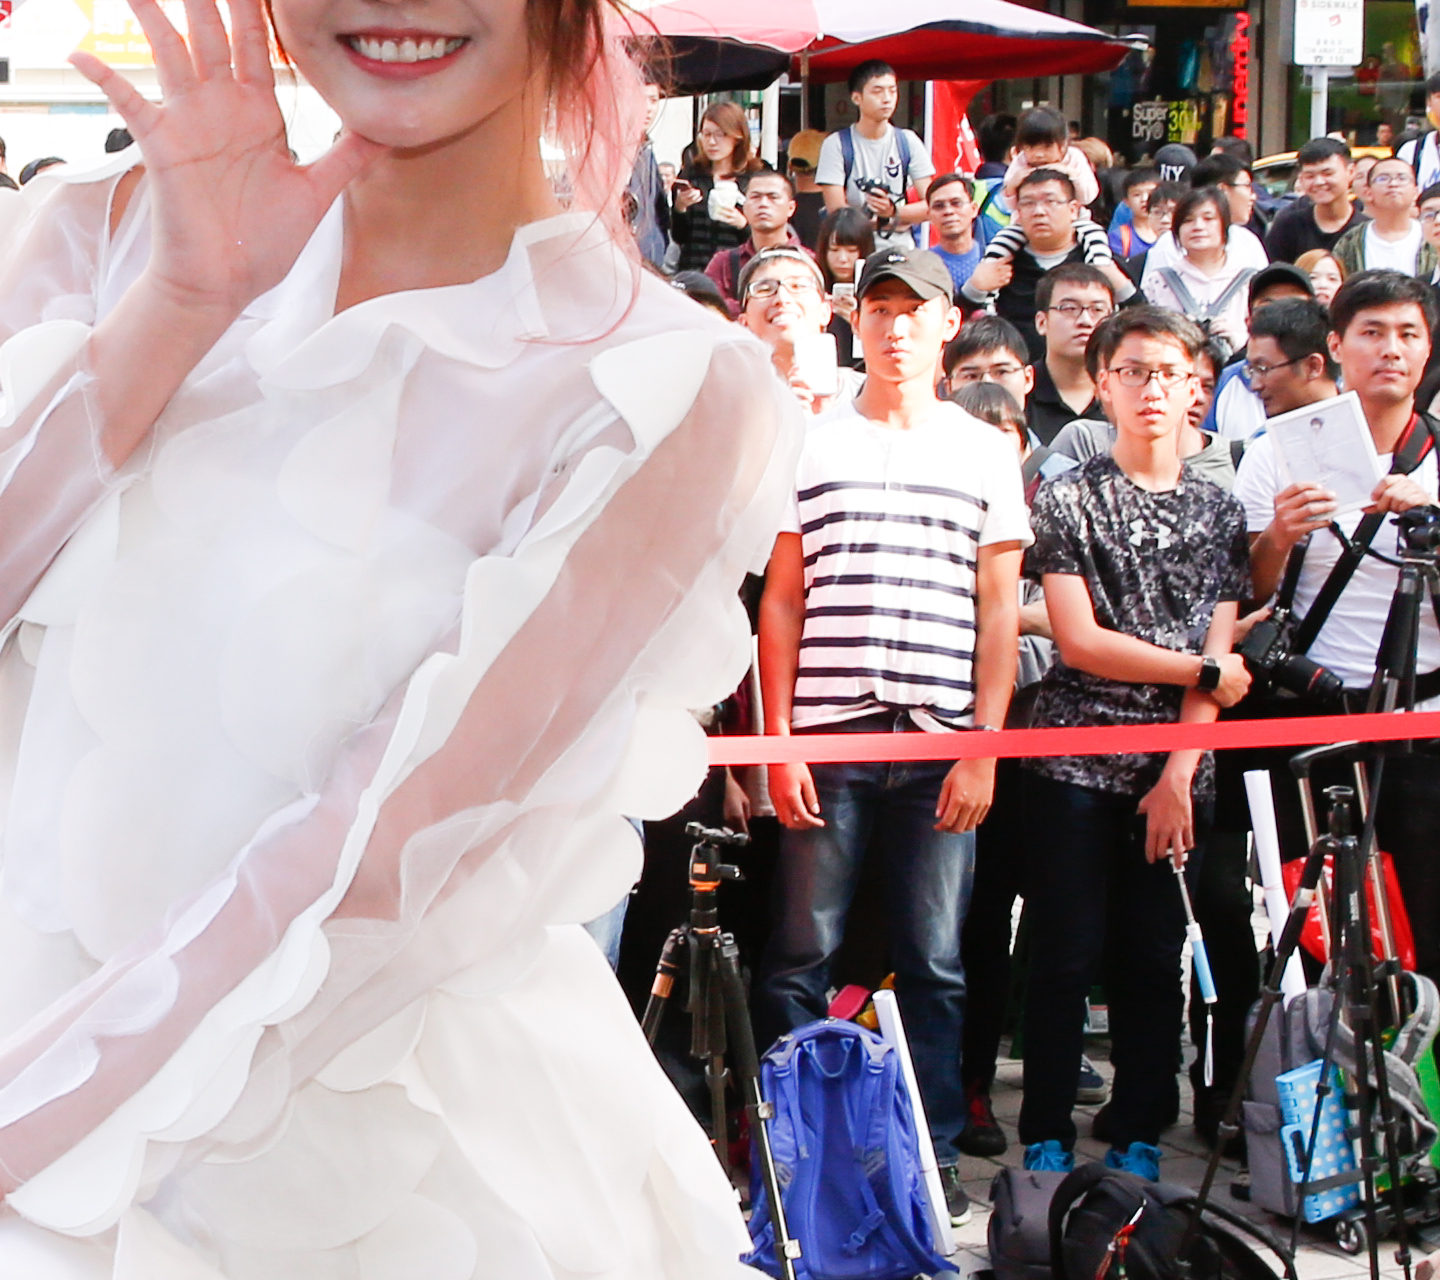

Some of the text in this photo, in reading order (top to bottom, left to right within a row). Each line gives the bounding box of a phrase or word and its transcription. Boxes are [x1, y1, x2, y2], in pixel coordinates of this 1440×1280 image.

[1312, 0, 1359, 9] SIDEWALK
[1133, 102, 1168, 122] Super
[1160, 163, 1185, 182] NY
